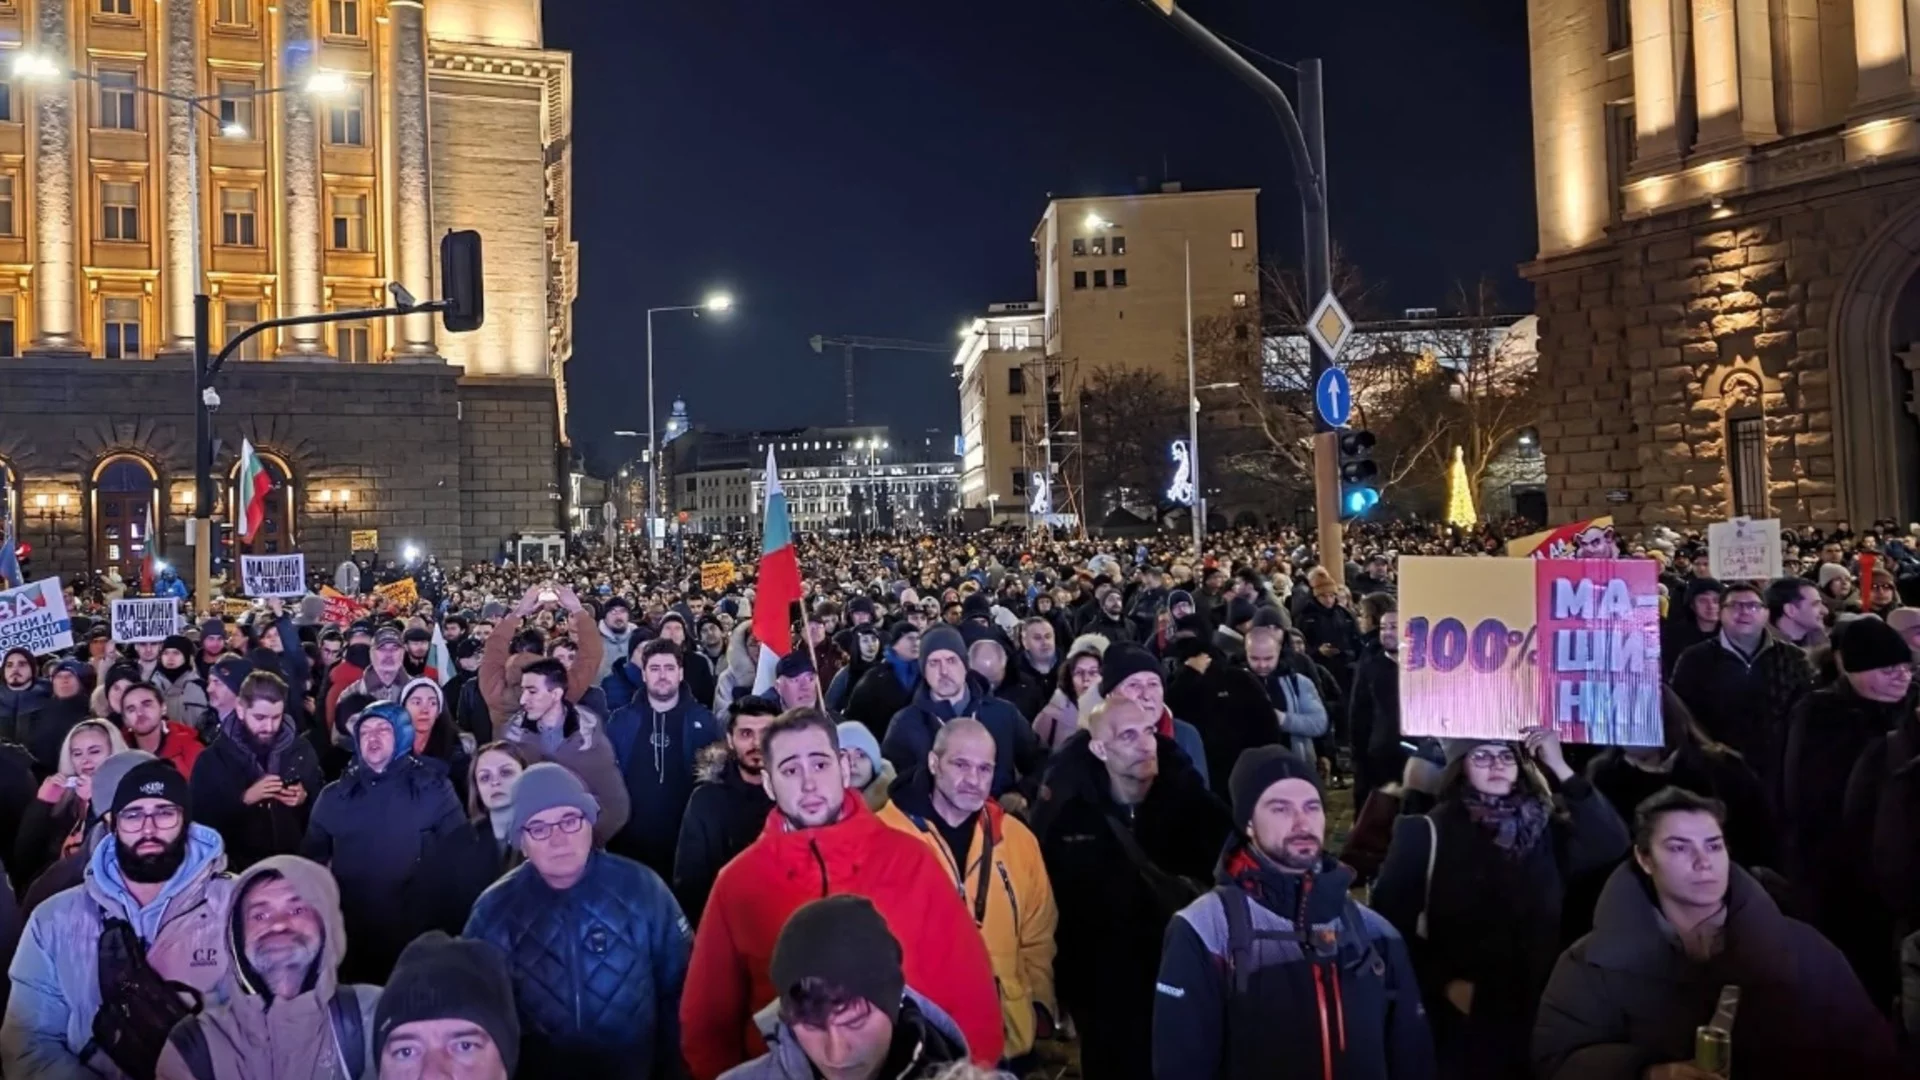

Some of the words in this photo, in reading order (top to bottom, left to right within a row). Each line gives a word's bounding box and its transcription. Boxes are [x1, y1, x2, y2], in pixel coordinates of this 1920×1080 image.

[246, 558, 300, 577] МАШИНИ
[1553, 578, 1658, 620] МА-
[41, 612, 53, 625] И
[117, 602, 173, 621] МАШИНИ
[1404, 616, 1538, 674] 100%
